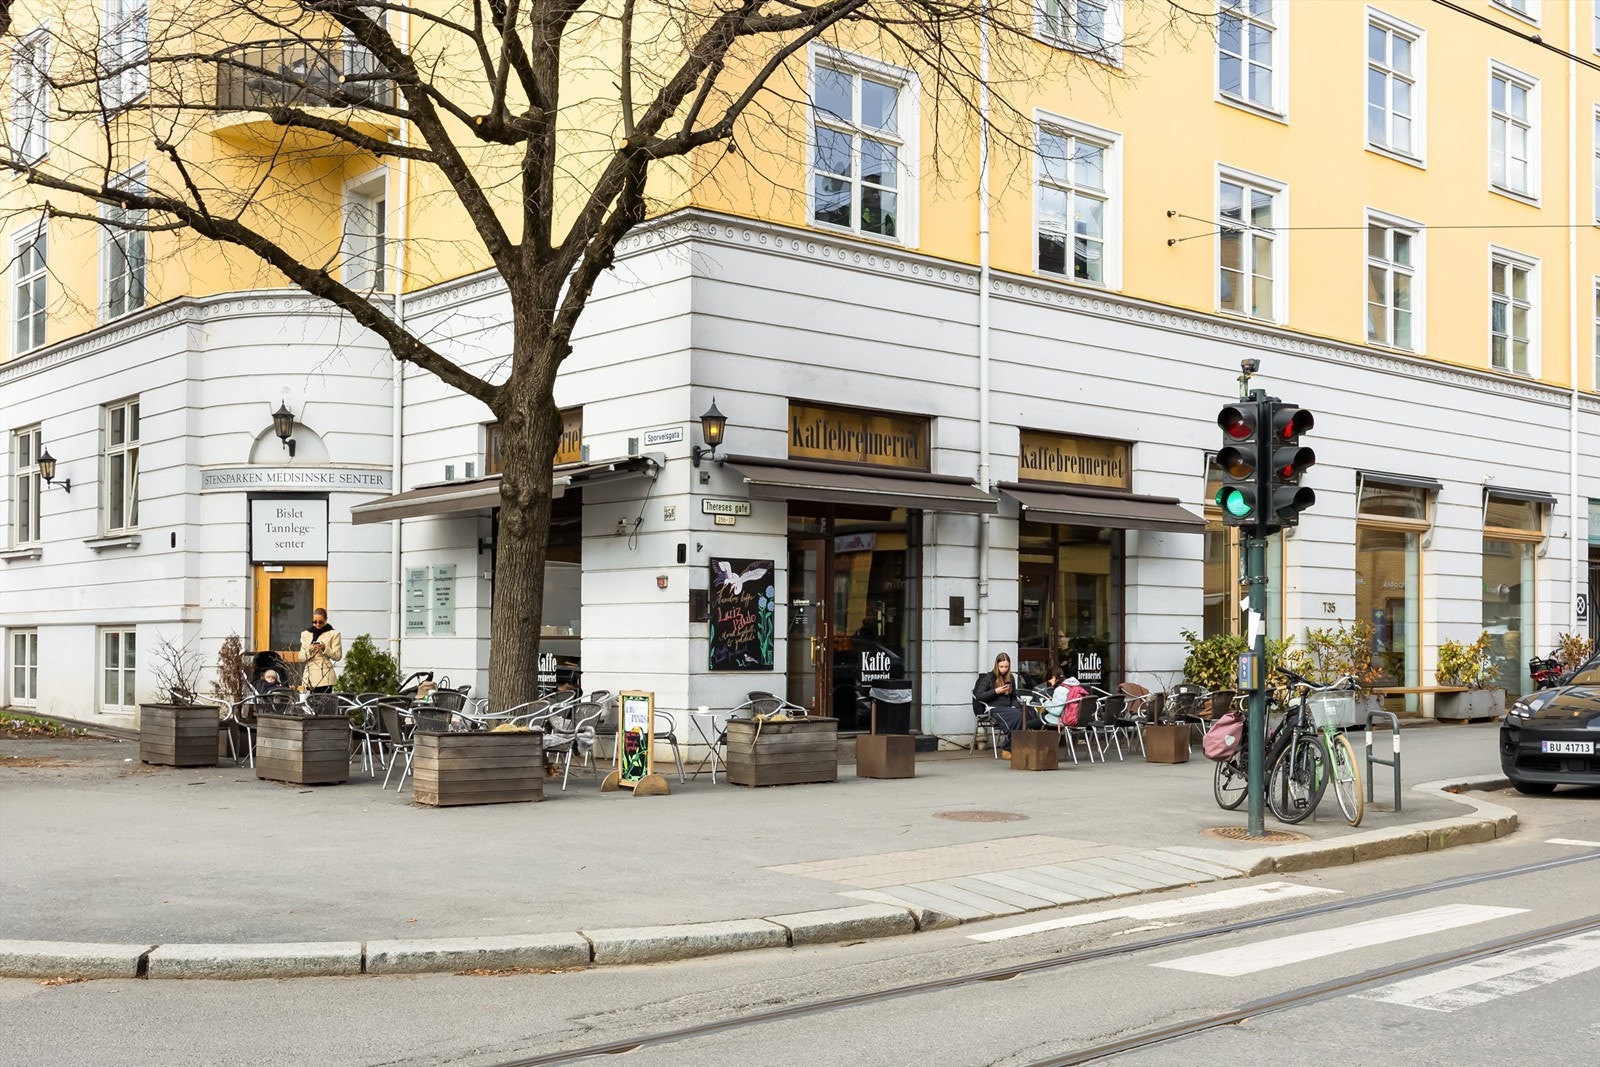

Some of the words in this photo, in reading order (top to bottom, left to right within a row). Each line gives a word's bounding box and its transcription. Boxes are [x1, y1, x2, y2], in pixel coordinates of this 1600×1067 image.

[647, 431, 680, 443] Sporveisgata
[792, 415, 920, 460] Kaffebrenneriet
[1020, 443, 1125, 479] Kaffebrenneriet
[205, 473, 263, 485] STENSPARKEN
[266, 472, 335, 483] MEDISINSKE
[339, 473, 384, 485] SENTER
[276, 508, 304, 519] Bislet
[706, 501, 733, 513] Thereses
[734, 504, 748, 514] gate
[265, 523, 316, 536] Tannlege-
[275, 539, 305, 549] senter
[1322, 602, 1336, 613] T35
[861, 651, 891, 672] Kaffe
[1077, 652, 1102, 671] Kaffe
[1549, 743, 1562, 752] BU
[1565, 743, 1590, 753] 41713
